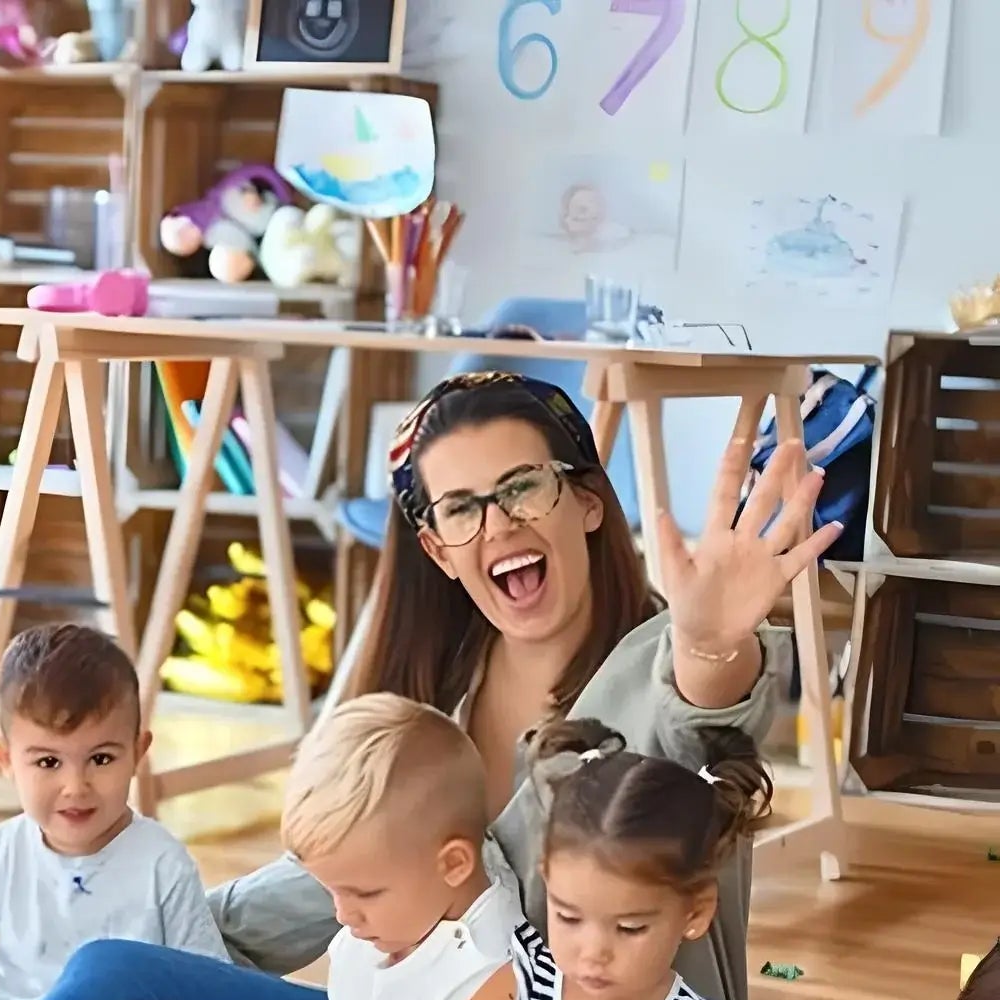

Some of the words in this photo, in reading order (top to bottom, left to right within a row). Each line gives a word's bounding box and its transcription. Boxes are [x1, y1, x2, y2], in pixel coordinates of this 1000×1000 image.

[499, 0, 561, 99] 6
[600, 0, 685, 116] 7
[715, 0, 791, 113] 8
[853, 0, 931, 118] 9
